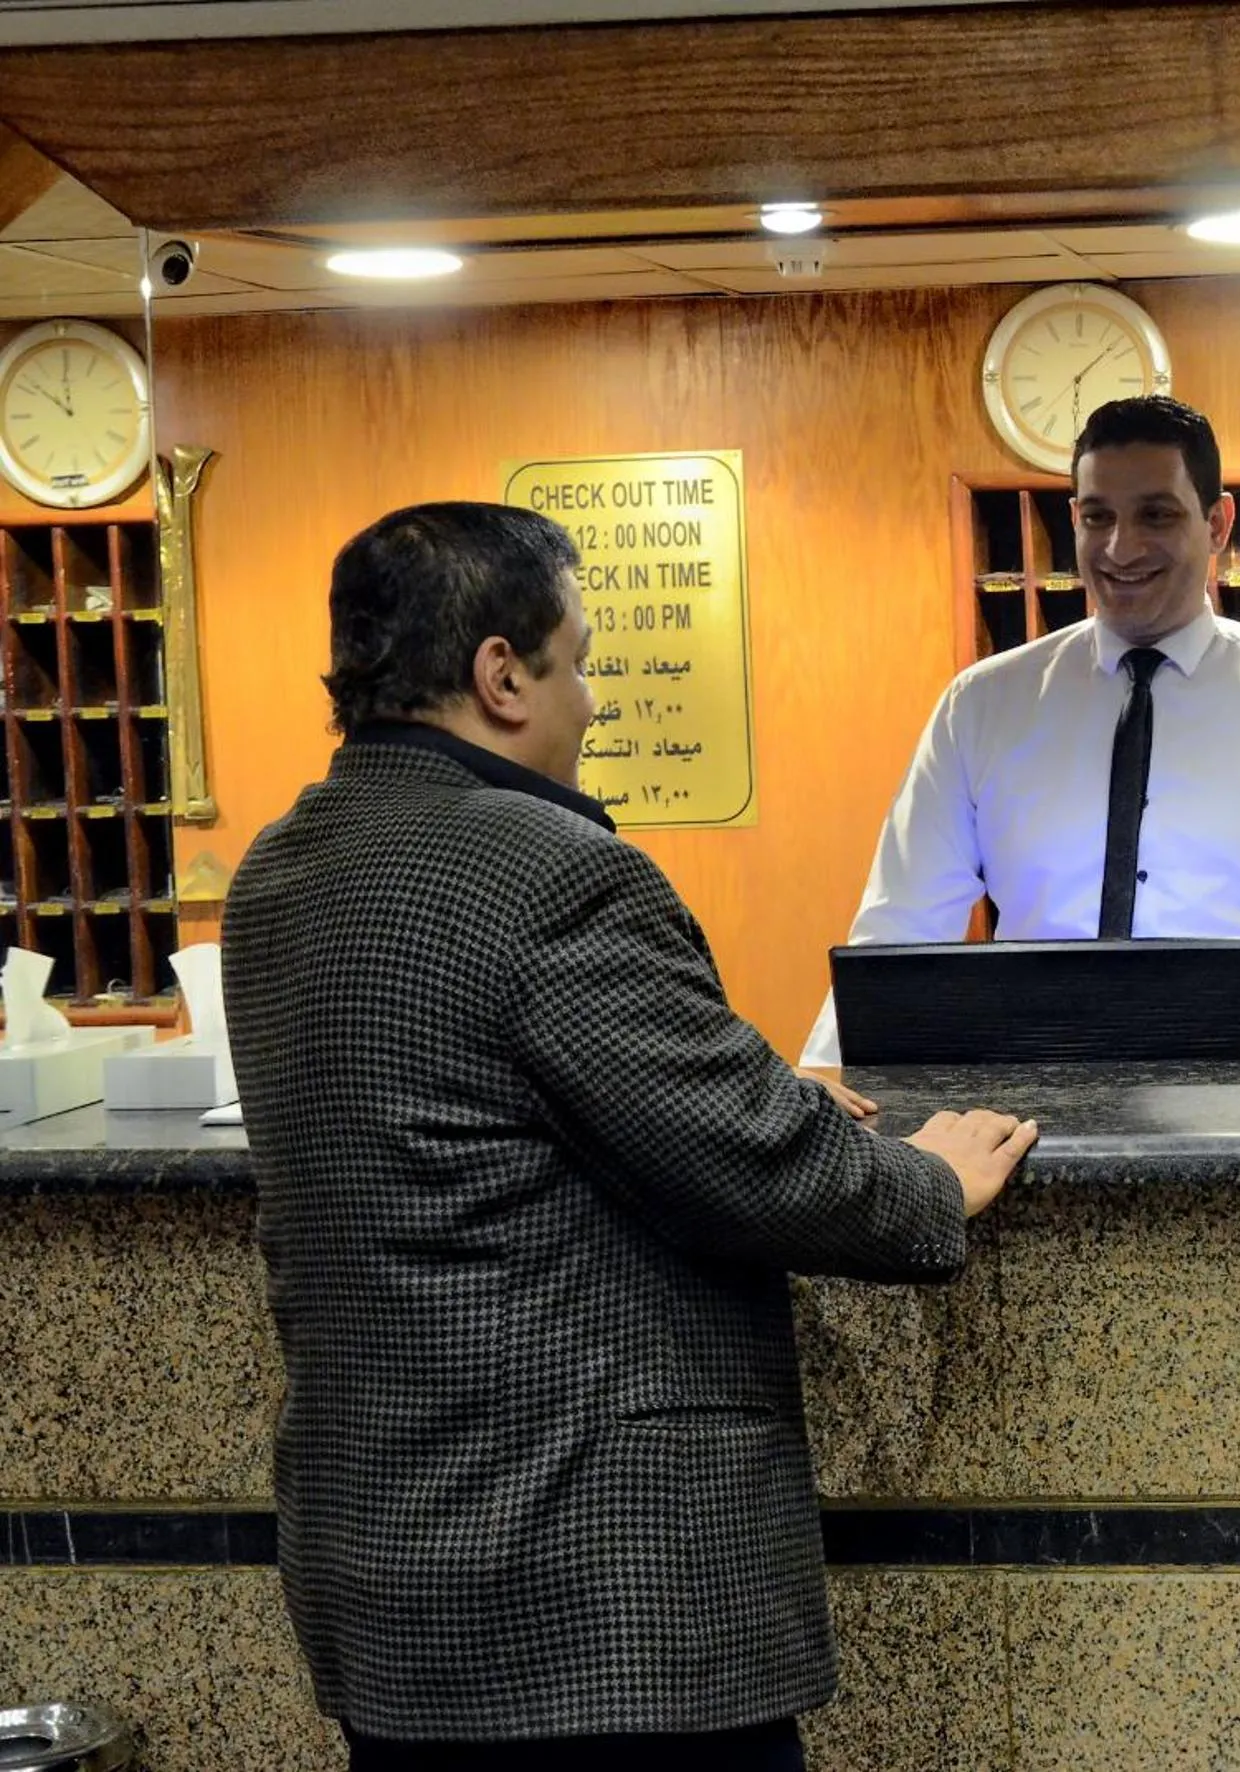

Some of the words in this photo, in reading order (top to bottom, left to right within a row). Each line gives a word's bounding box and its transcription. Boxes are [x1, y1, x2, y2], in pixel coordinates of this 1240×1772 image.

[530, 484, 606, 510] CHECK
[611, 481, 656, 508] OUT
[662, 479, 714, 505] TIME
[643, 520, 701, 547] NOON
[574, 565, 621, 591] ECK
[628, 563, 649, 589] IN
[657, 561, 712, 589] TIME
[662, 603, 692, 629] PM
[586, 656, 629, 677] المغاد
[642, 656, 691, 682] ميعاد
[653, 738, 702, 762] ميعاد
